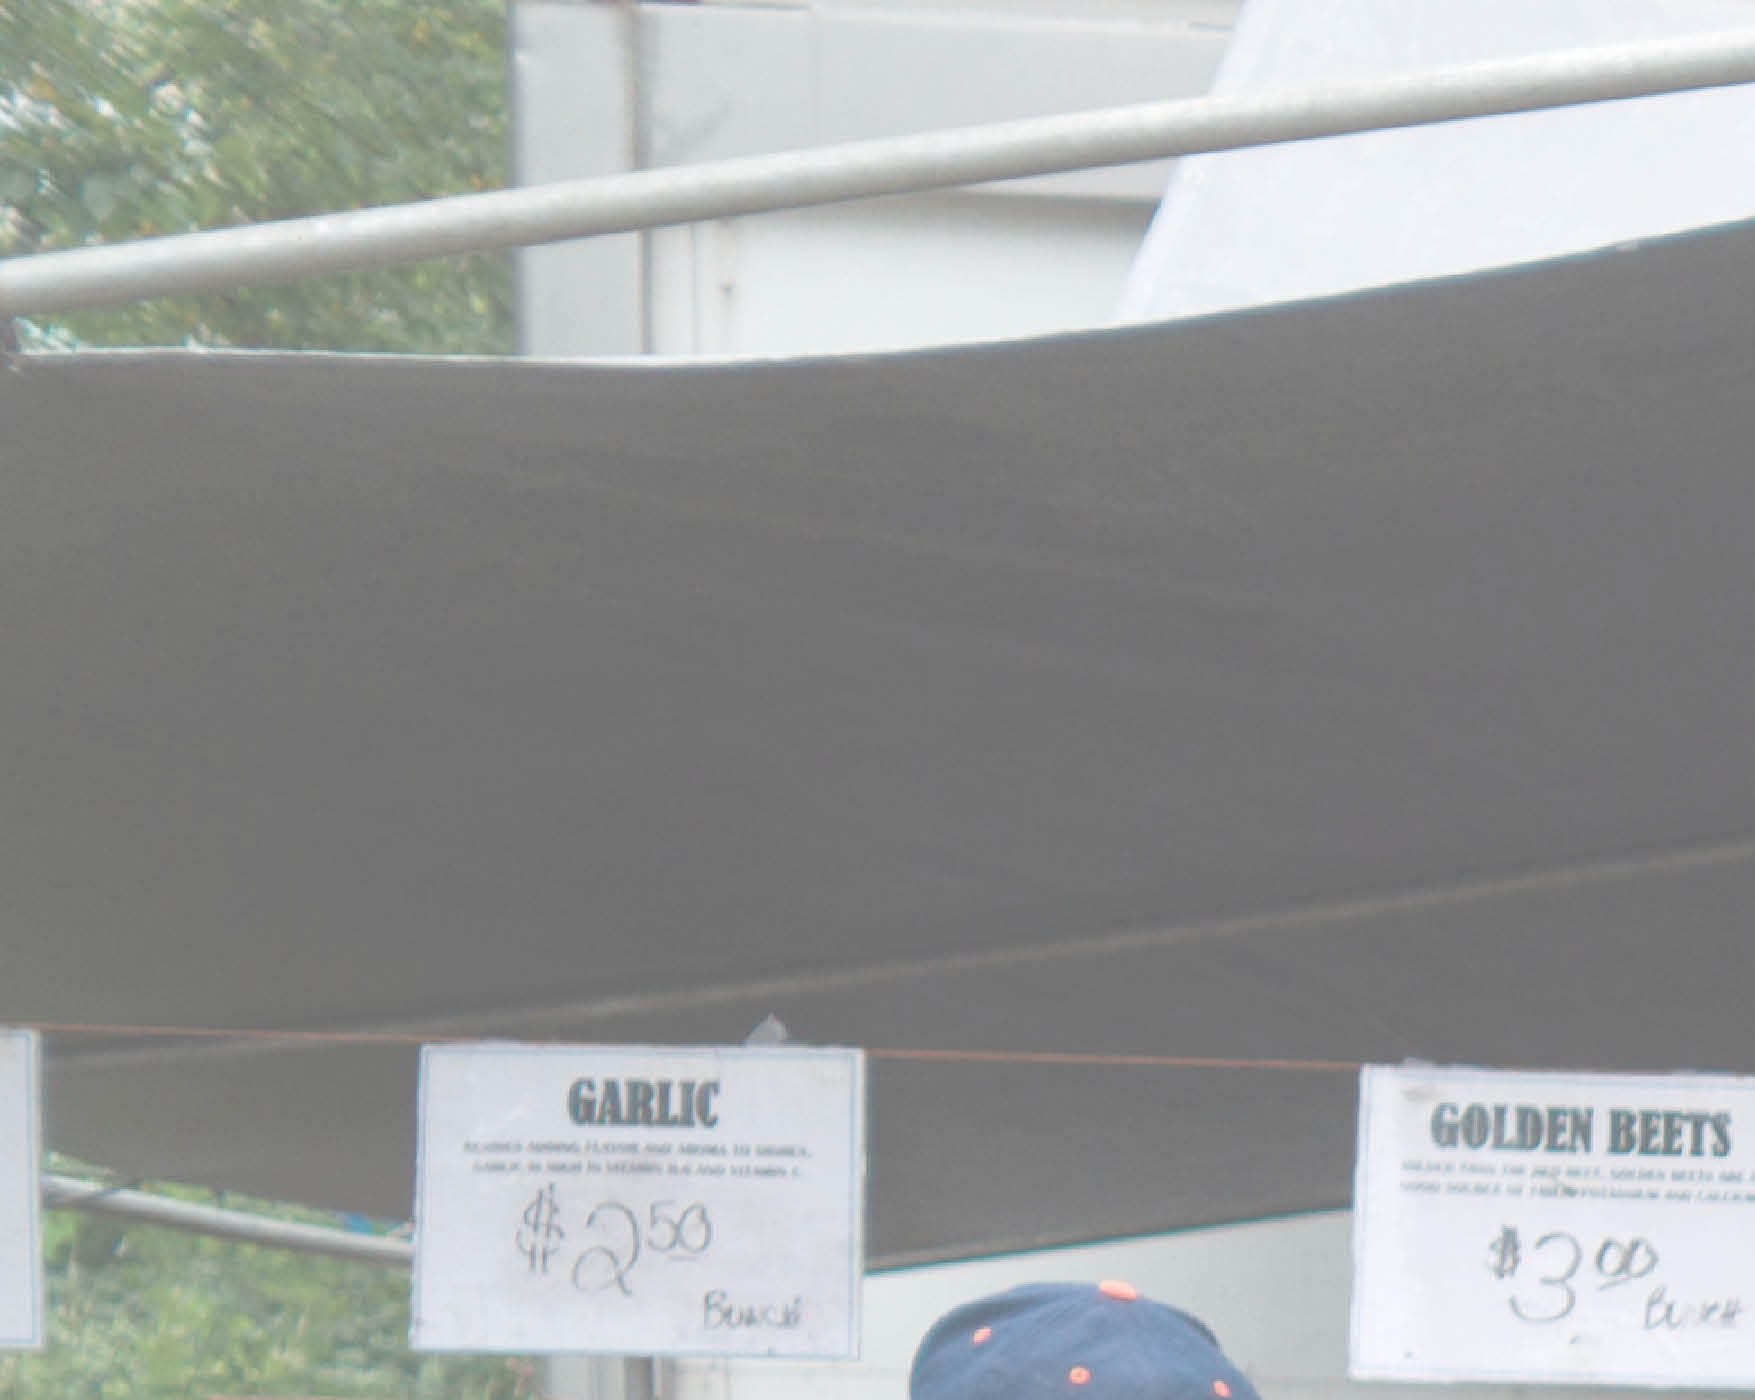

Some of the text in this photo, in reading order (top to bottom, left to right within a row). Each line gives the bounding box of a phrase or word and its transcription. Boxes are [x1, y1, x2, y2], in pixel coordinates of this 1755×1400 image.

[567, 1077, 721, 1128] GARLIC
[1431, 1101, 1733, 1158] GOLDEN BEETS
